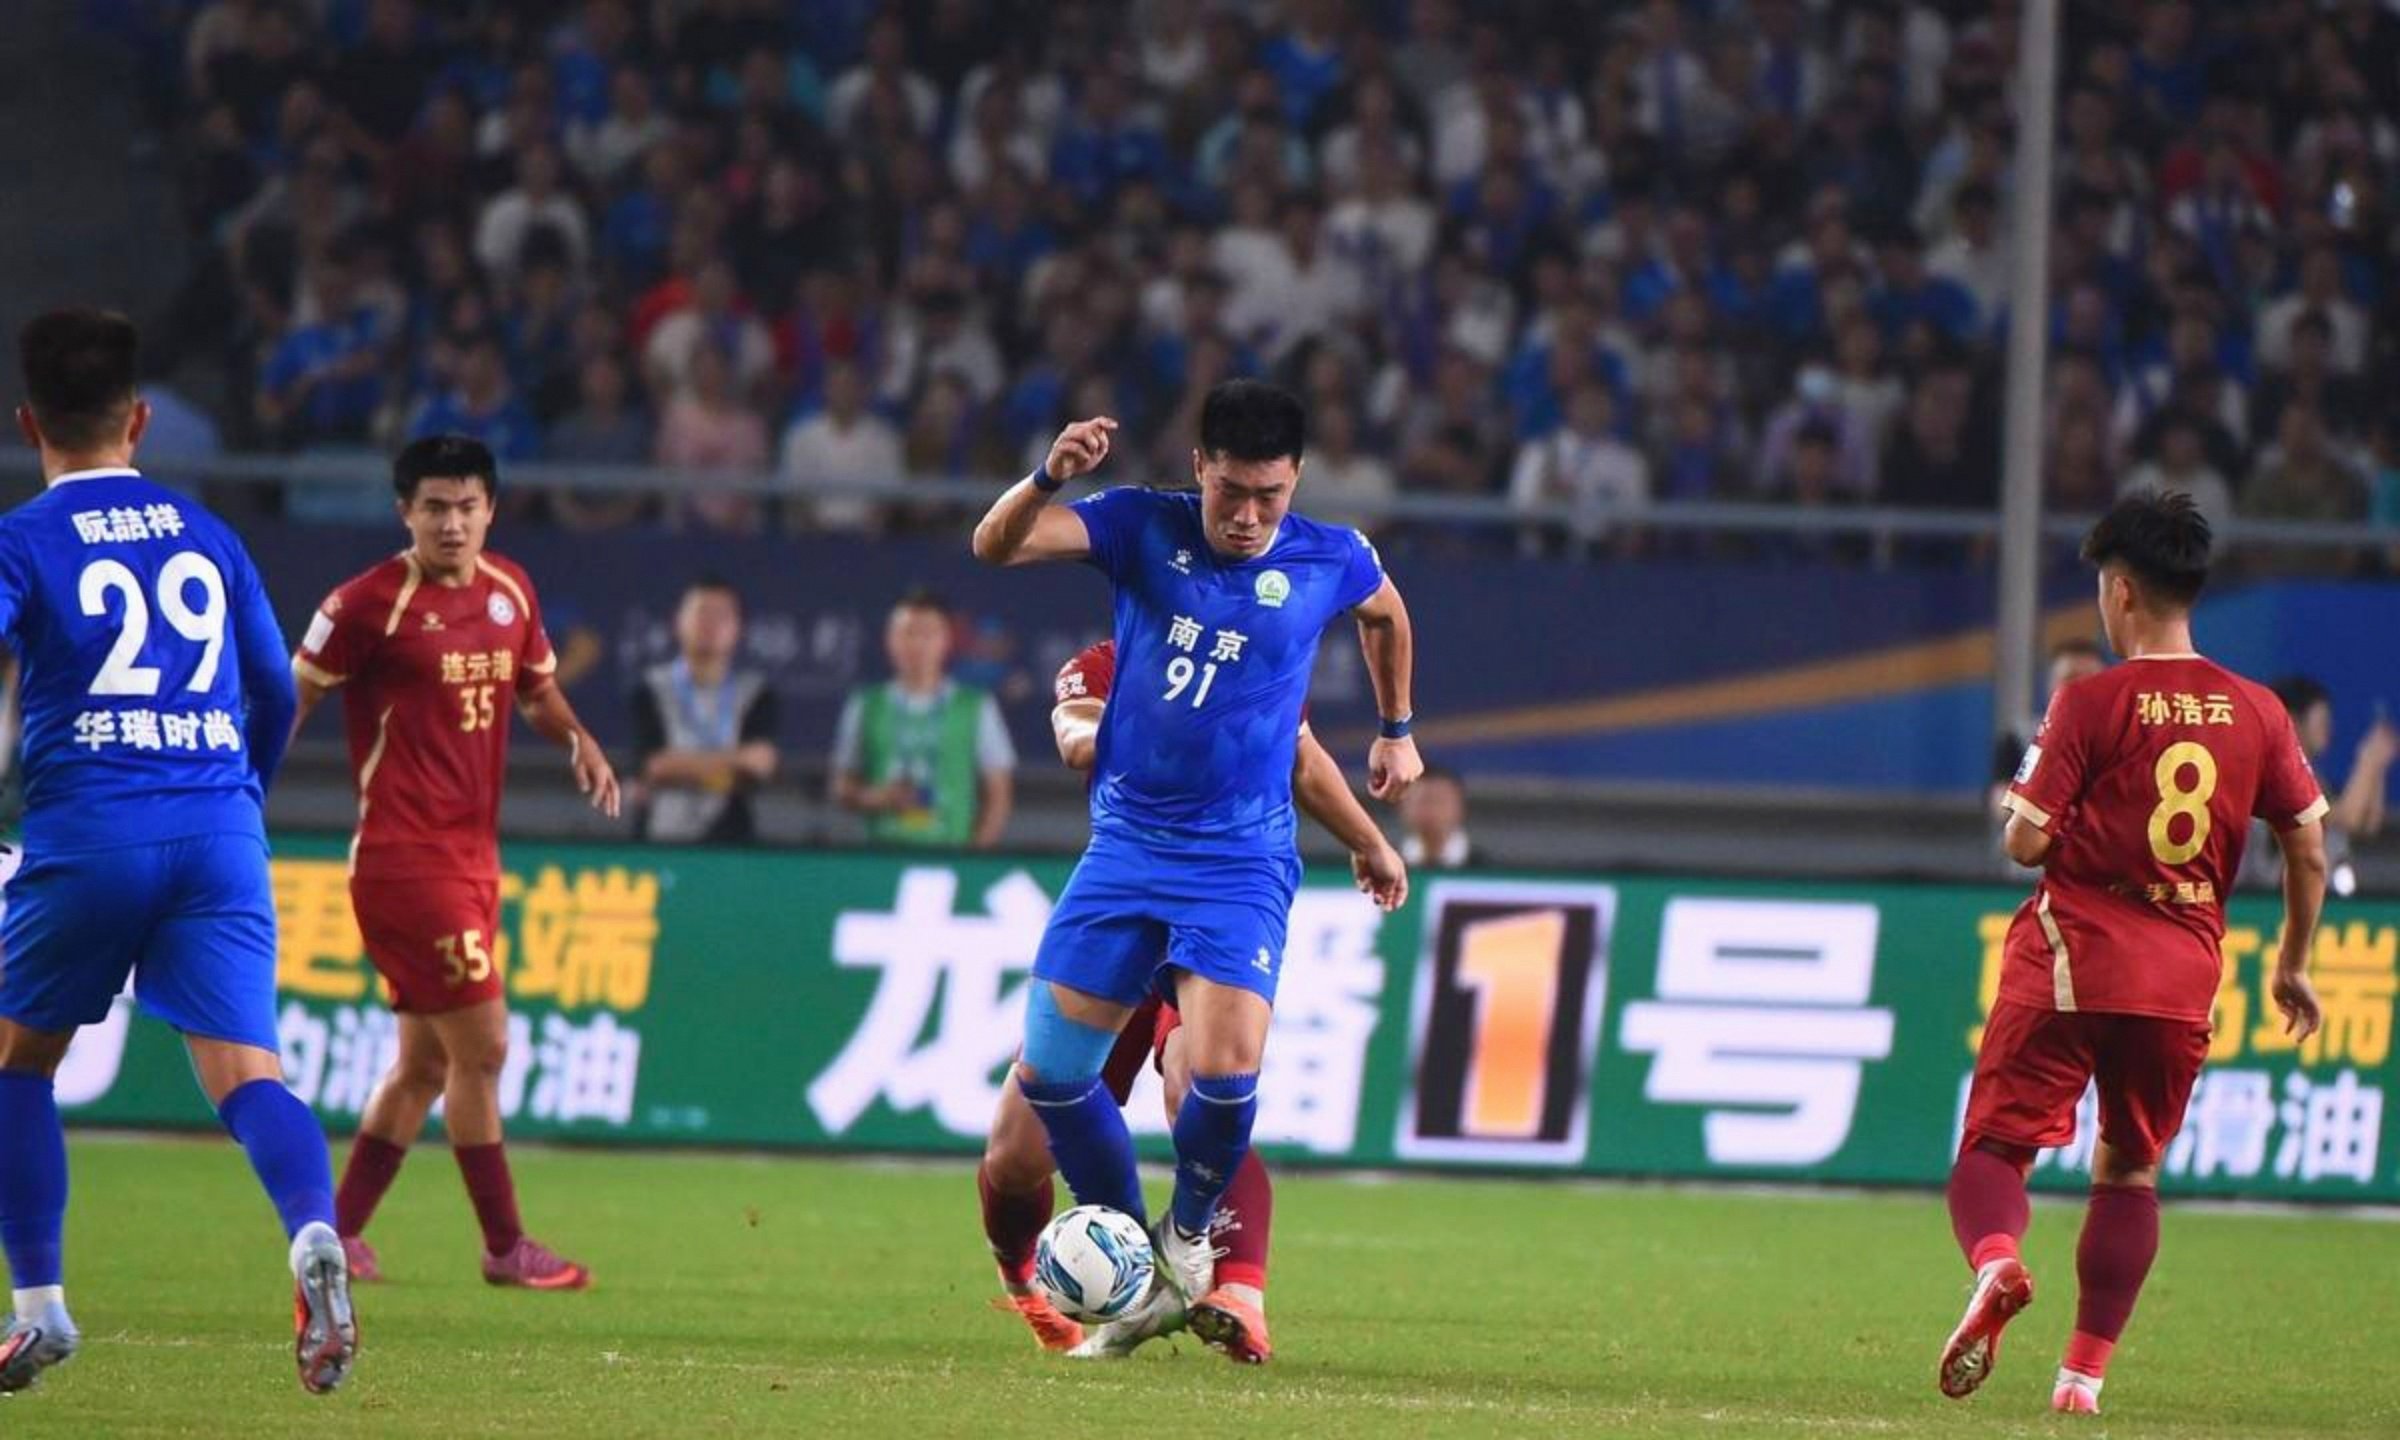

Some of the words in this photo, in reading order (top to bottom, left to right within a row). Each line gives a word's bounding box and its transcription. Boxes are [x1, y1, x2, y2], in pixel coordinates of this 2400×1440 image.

[71, 503, 184, 545] 阮喆祥
[78, 550, 226, 696] 29
[1166, 614, 1249, 662] 南京
[441, 649, 513, 684] 连云港
[1162, 655, 1217, 708] 91
[73, 708, 240, 752] 华瑞时尚
[460, 685, 495, 732] 35
[2137, 691, 2234, 726] 孙浩云
[2147, 740, 2218, 865] 8
[270, 858, 659, 1012] 更端
[434, 929, 491, 987] 35
